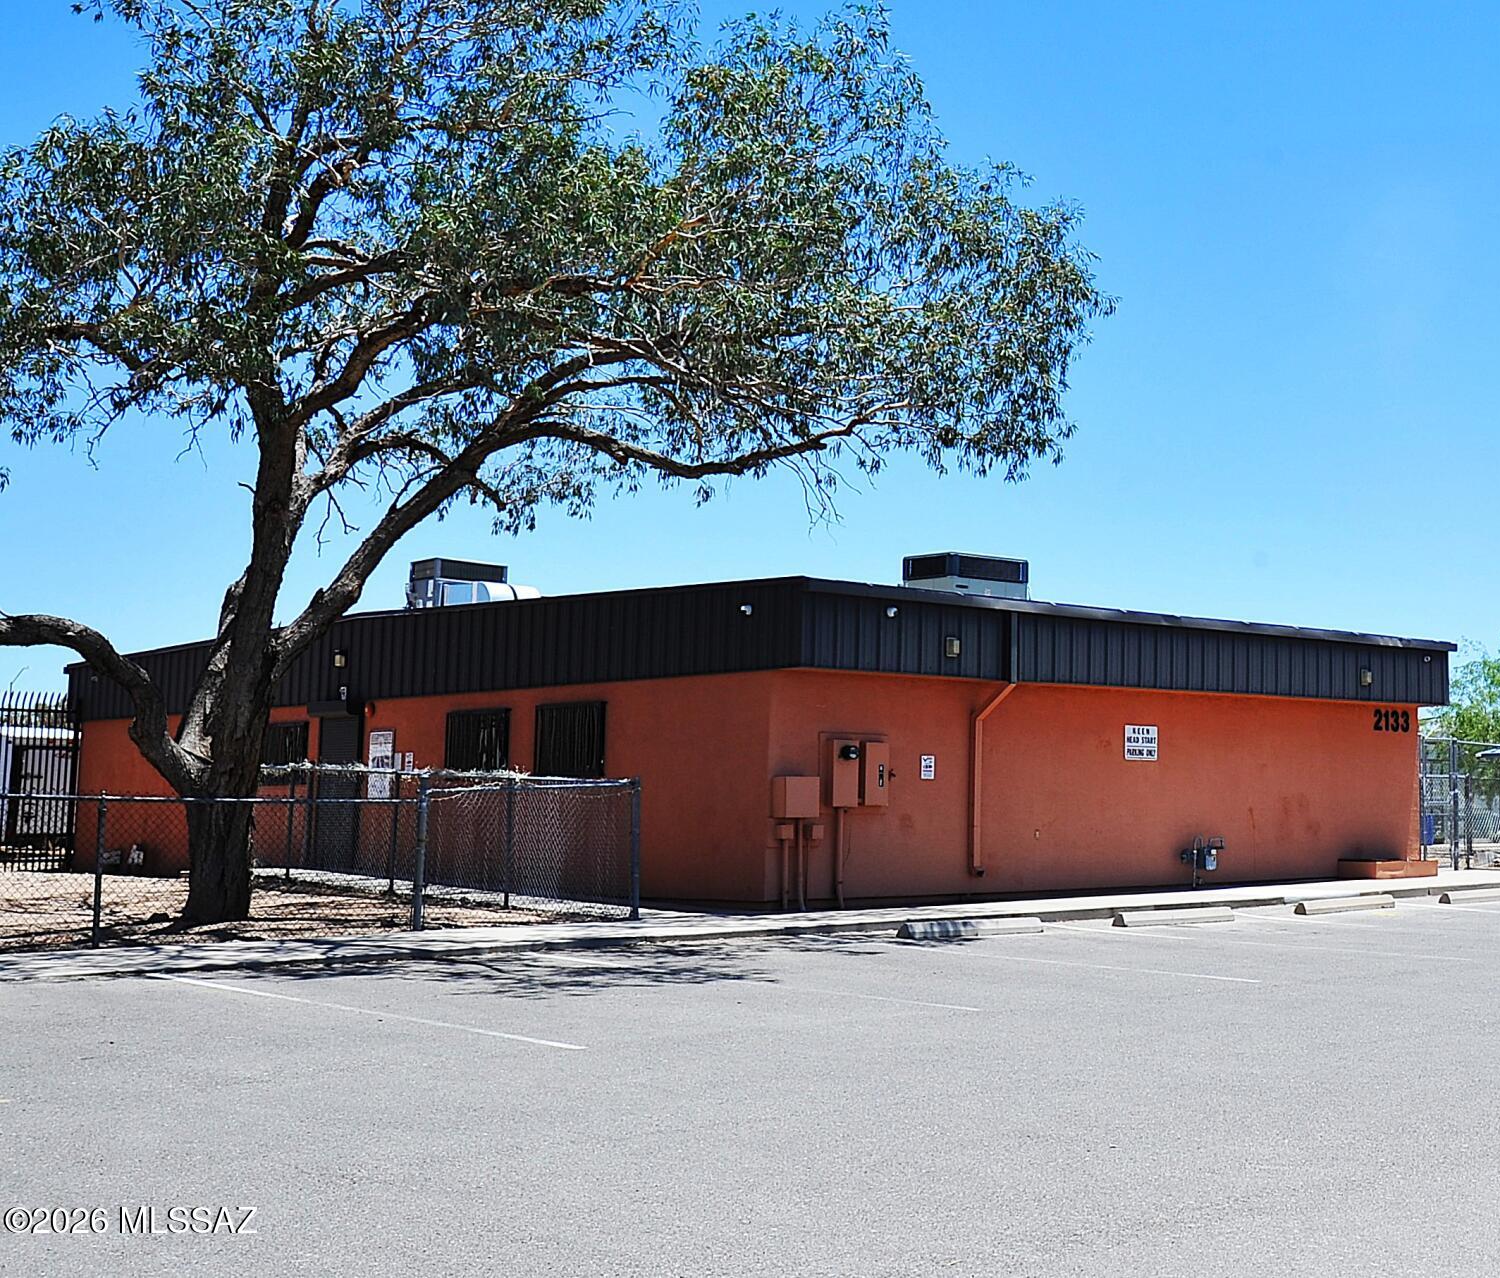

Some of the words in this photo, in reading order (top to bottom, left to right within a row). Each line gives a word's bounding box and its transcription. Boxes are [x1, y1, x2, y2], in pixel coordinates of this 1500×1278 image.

[1373, 709, 1410, 733] 2133
[1126, 736, 1140, 744] HEAD
[1141, 737, 1156, 745] START
[1126, 748, 1144, 756] PARKING
[1146, 749, 1156, 757] ONLY
